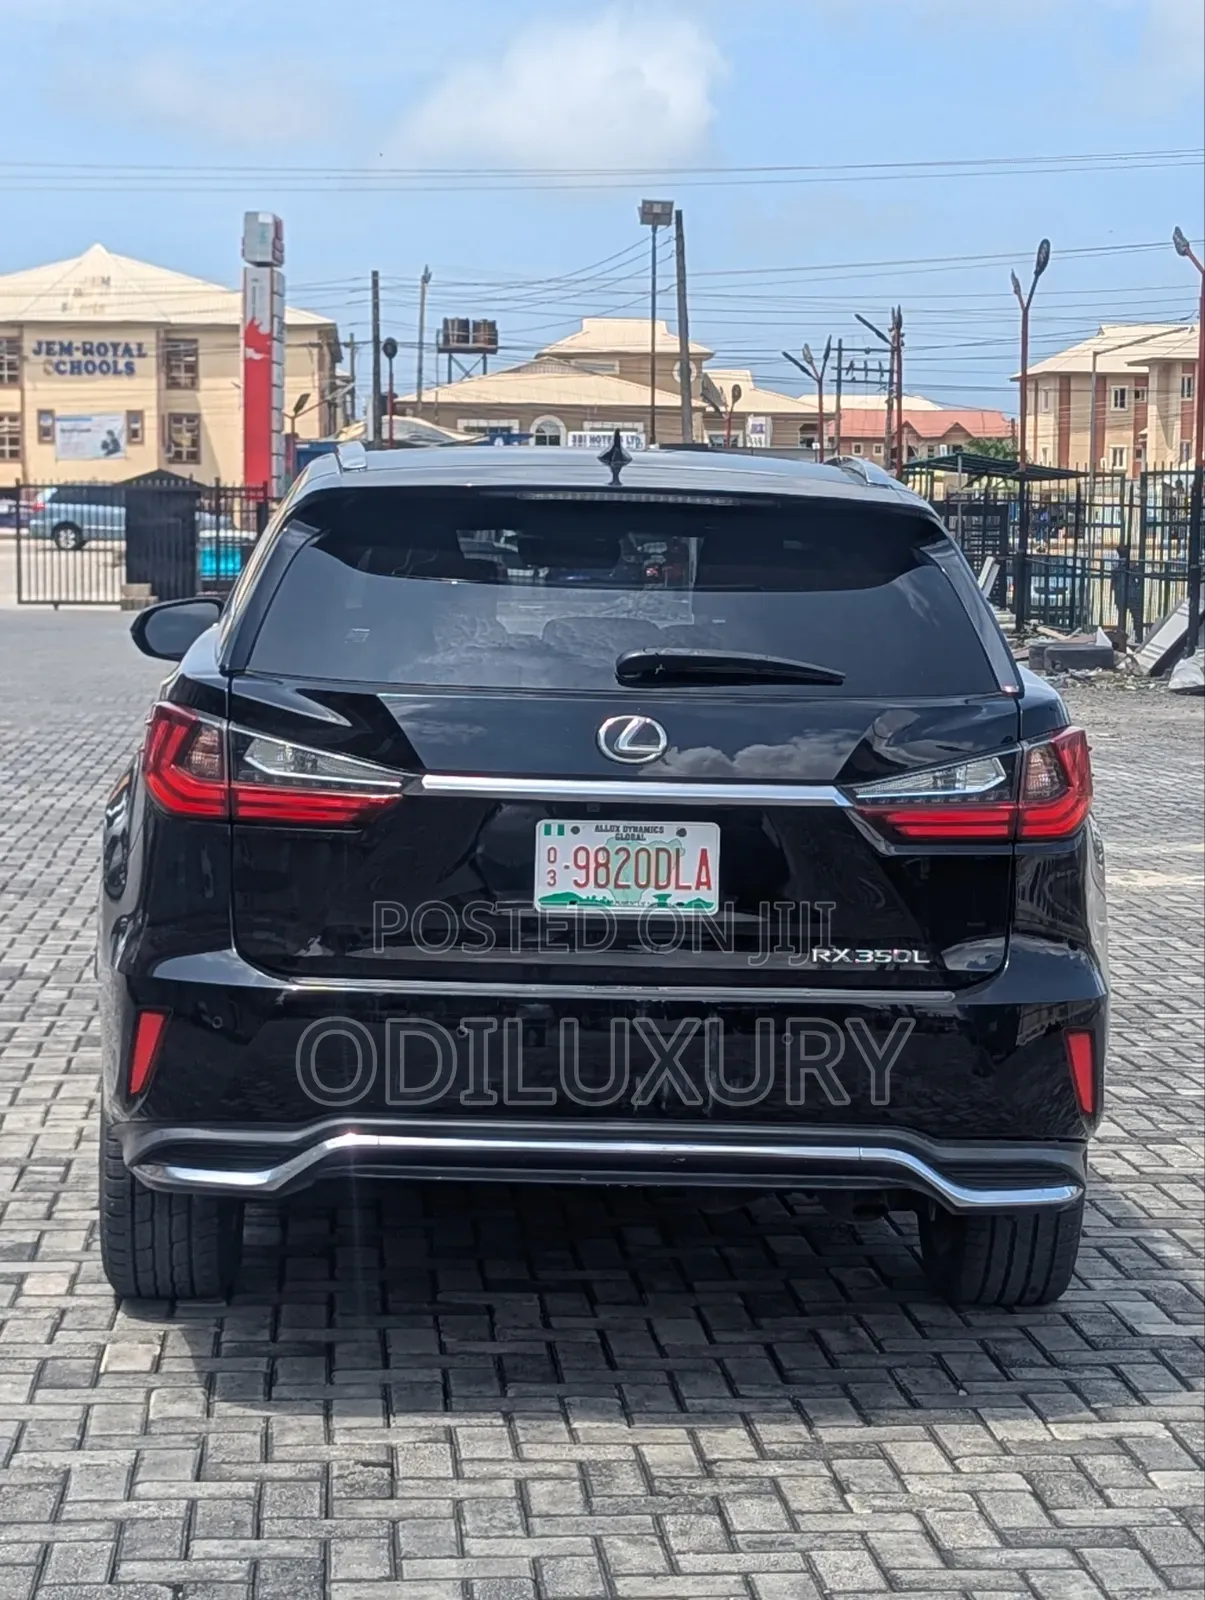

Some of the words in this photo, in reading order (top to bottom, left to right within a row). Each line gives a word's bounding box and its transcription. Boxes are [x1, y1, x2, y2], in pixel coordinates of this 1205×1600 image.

[32, 340, 148, 358] JEM-ROYAL
[622, 826, 664, 834] DYNAMICS
[615, 833, 646, 841] GLOBAL
